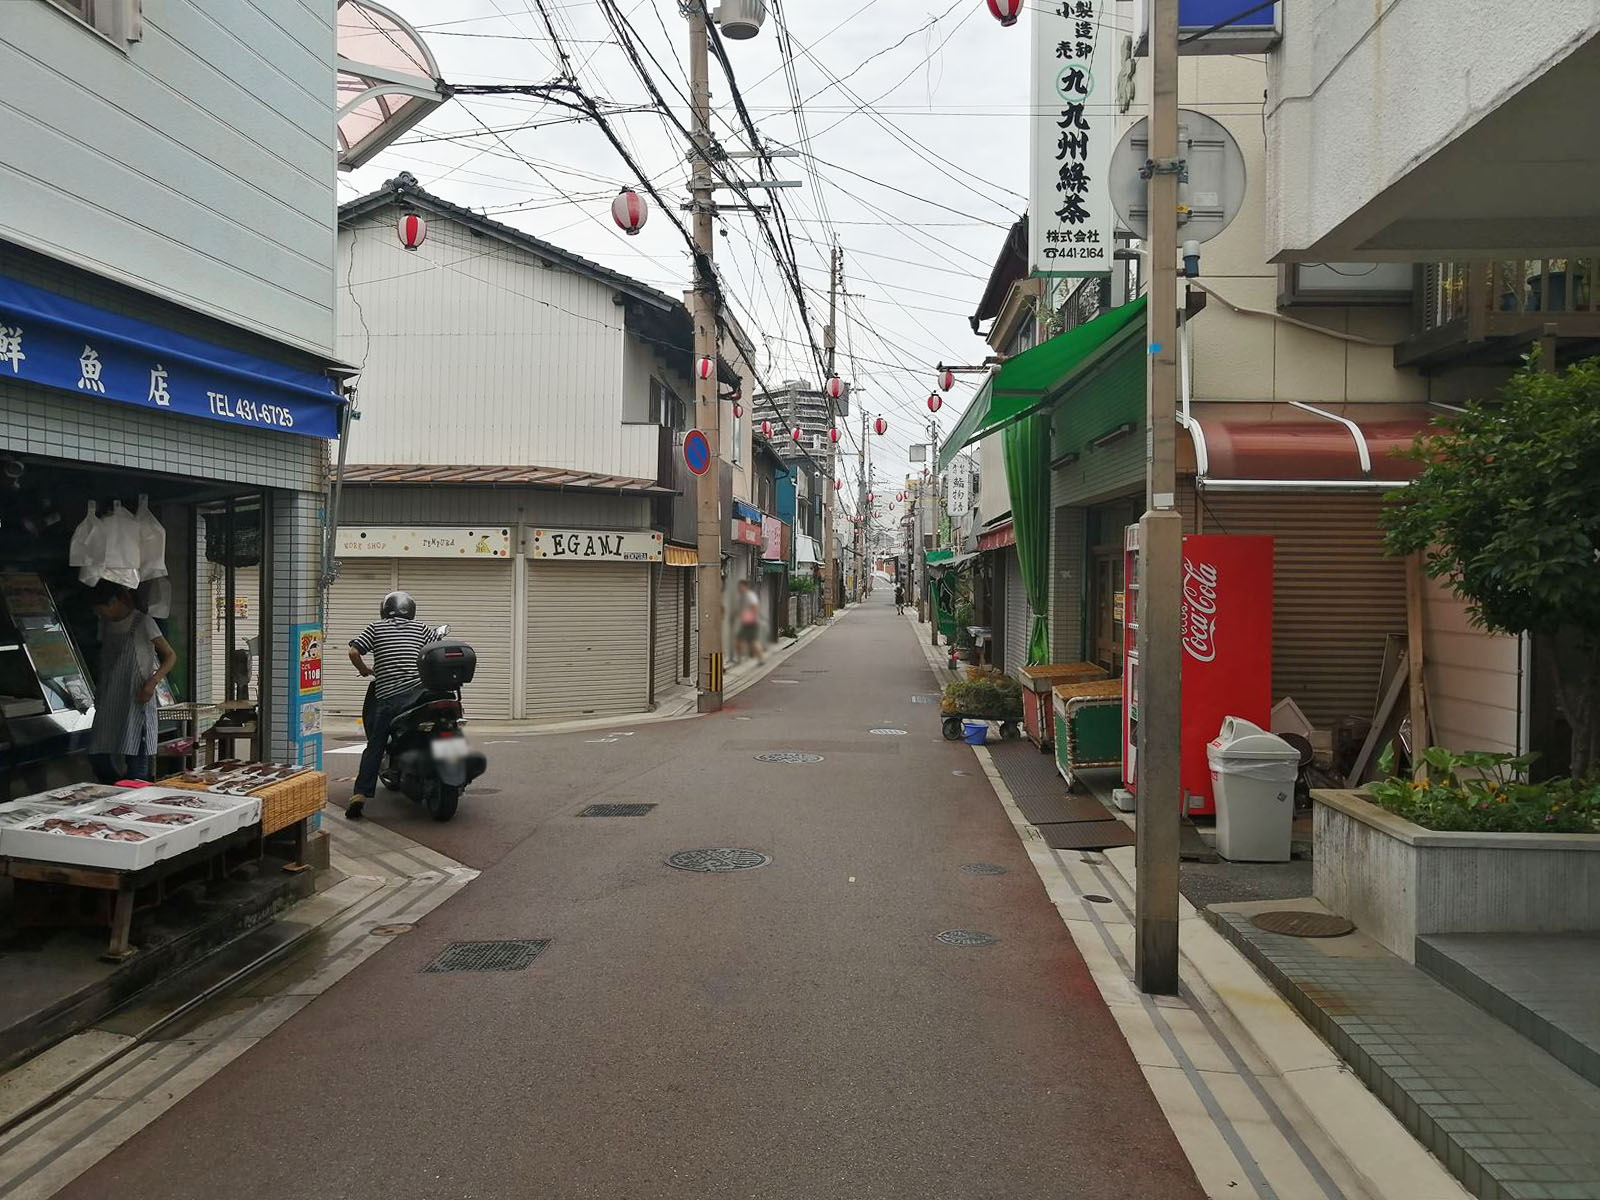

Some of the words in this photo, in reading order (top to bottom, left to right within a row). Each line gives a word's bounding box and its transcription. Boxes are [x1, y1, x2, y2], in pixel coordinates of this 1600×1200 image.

[1056, 1, 1074, 60] 小売
[1075, 0, 1094, 60] 製造卸
[1046, 229, 1100, 243] 株式会社
[206, 391, 236, 419] TEL
[235, 398, 294, 428] 431-6725
[551, 533, 625, 557] EGAMI
[1183, 556, 1218, 662] Coca-Cola
